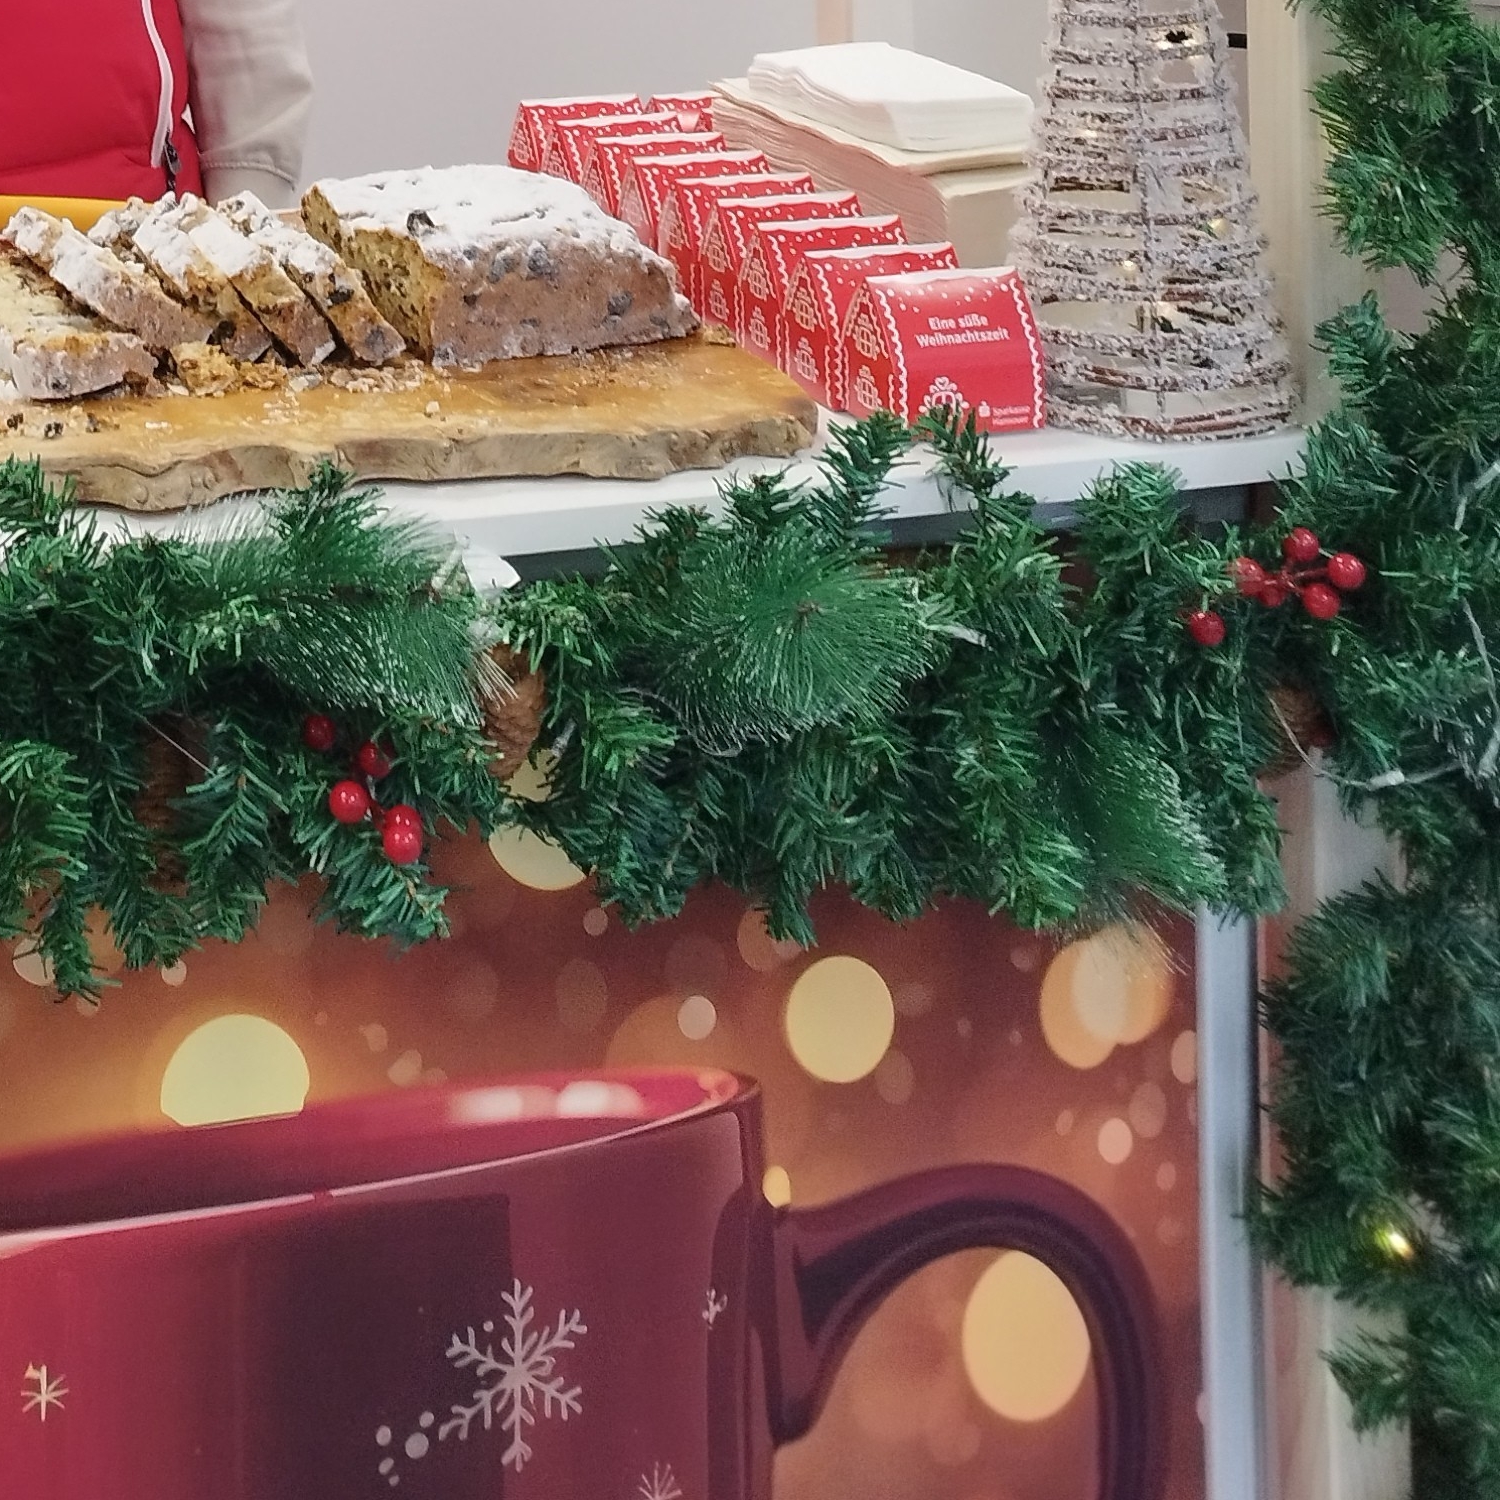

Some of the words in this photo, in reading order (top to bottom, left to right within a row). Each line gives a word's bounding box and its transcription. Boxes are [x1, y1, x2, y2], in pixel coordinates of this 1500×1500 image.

[928, 316, 956, 330] Eine
[958, 312, 989, 328] süße
[914, 326, 1011, 348] Weihnachtszeit
